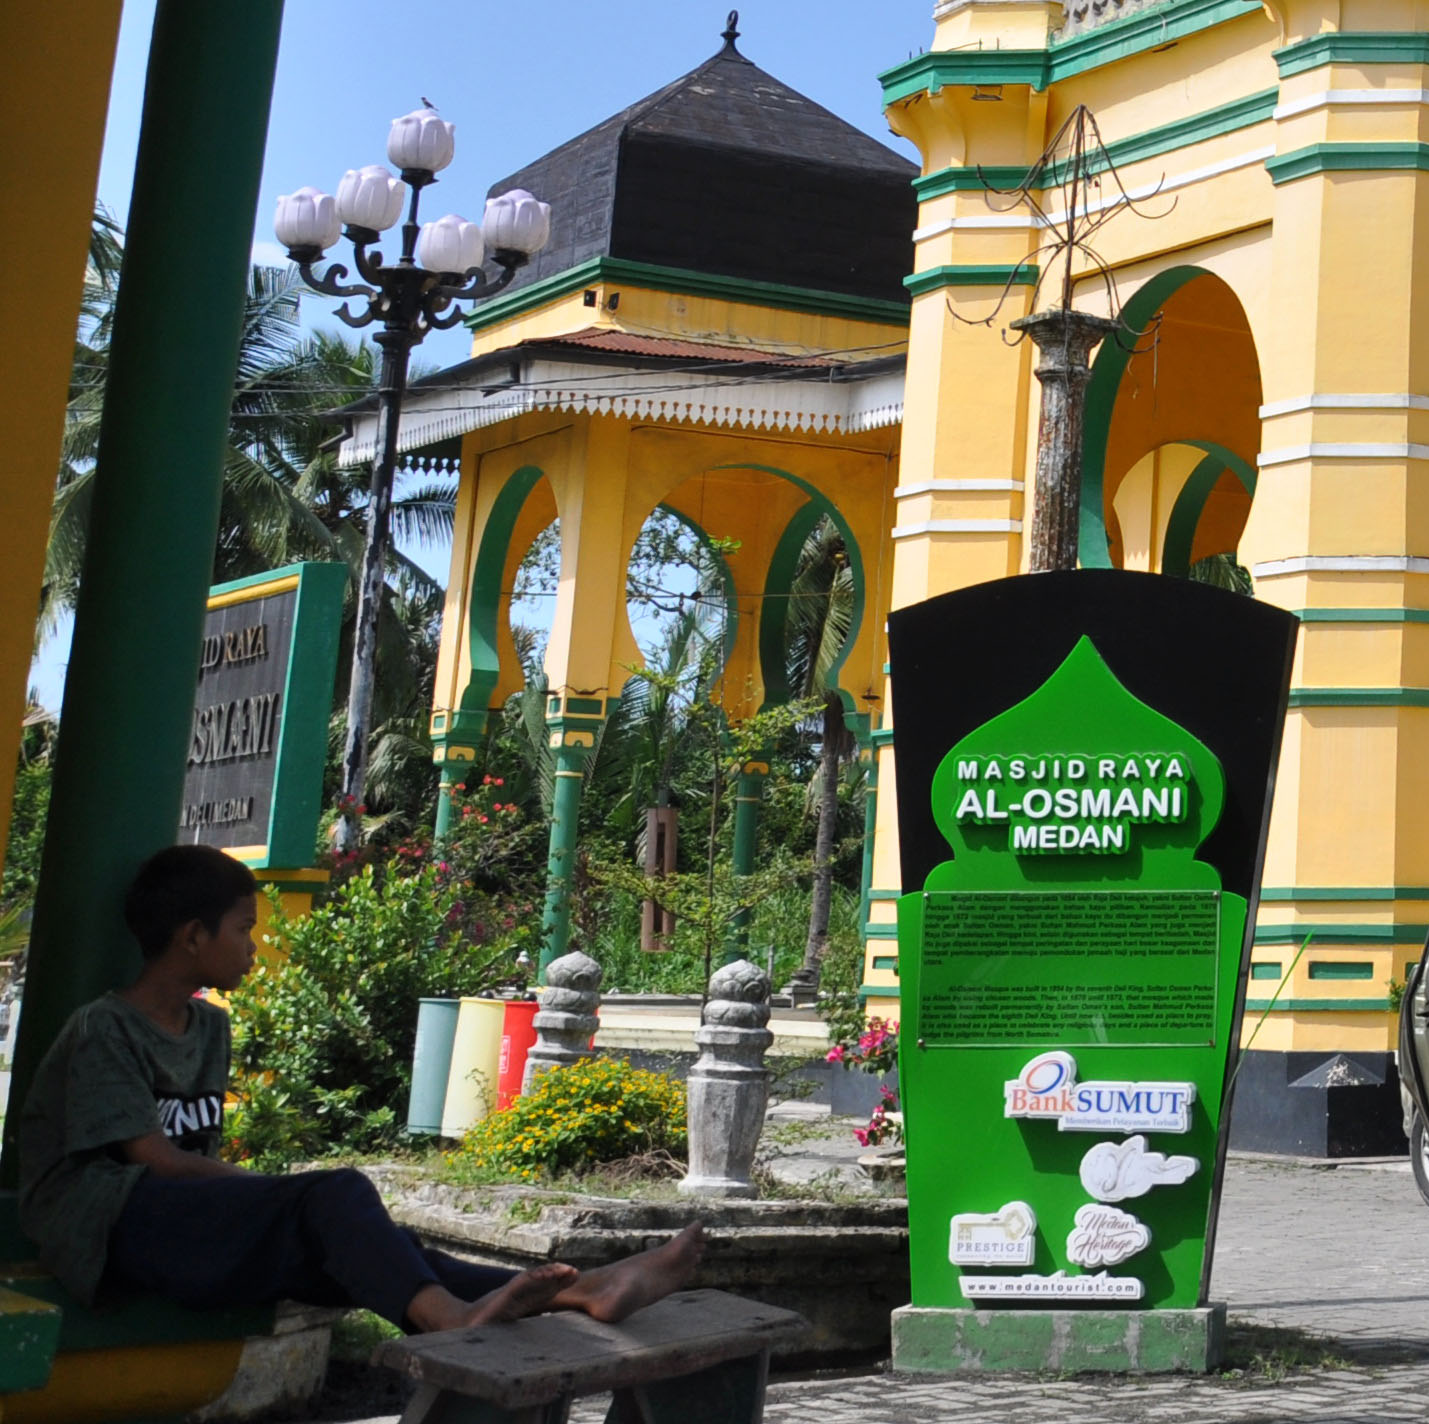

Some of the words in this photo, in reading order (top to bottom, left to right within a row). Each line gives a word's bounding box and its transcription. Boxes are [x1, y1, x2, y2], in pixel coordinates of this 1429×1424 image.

[201, 636, 221, 669] ID
[223, 625, 266, 664] RAYA
[190, 695, 277, 764] SMANI
[958, 760, 1087, 779] MASJID
[1098, 758, 1184, 778] RAYA
[213, 797, 251, 823] MEDAN
[956, 787, 1181, 819] AL-OSMANI
[1013, 825, 1124, 849] MEDAN
[1081, 1211, 1133, 1235] Medan
[957, 1242, 1025, 1252] PRESTIGE
[968, 1280, 1135, 1293] www.medantourist.com
